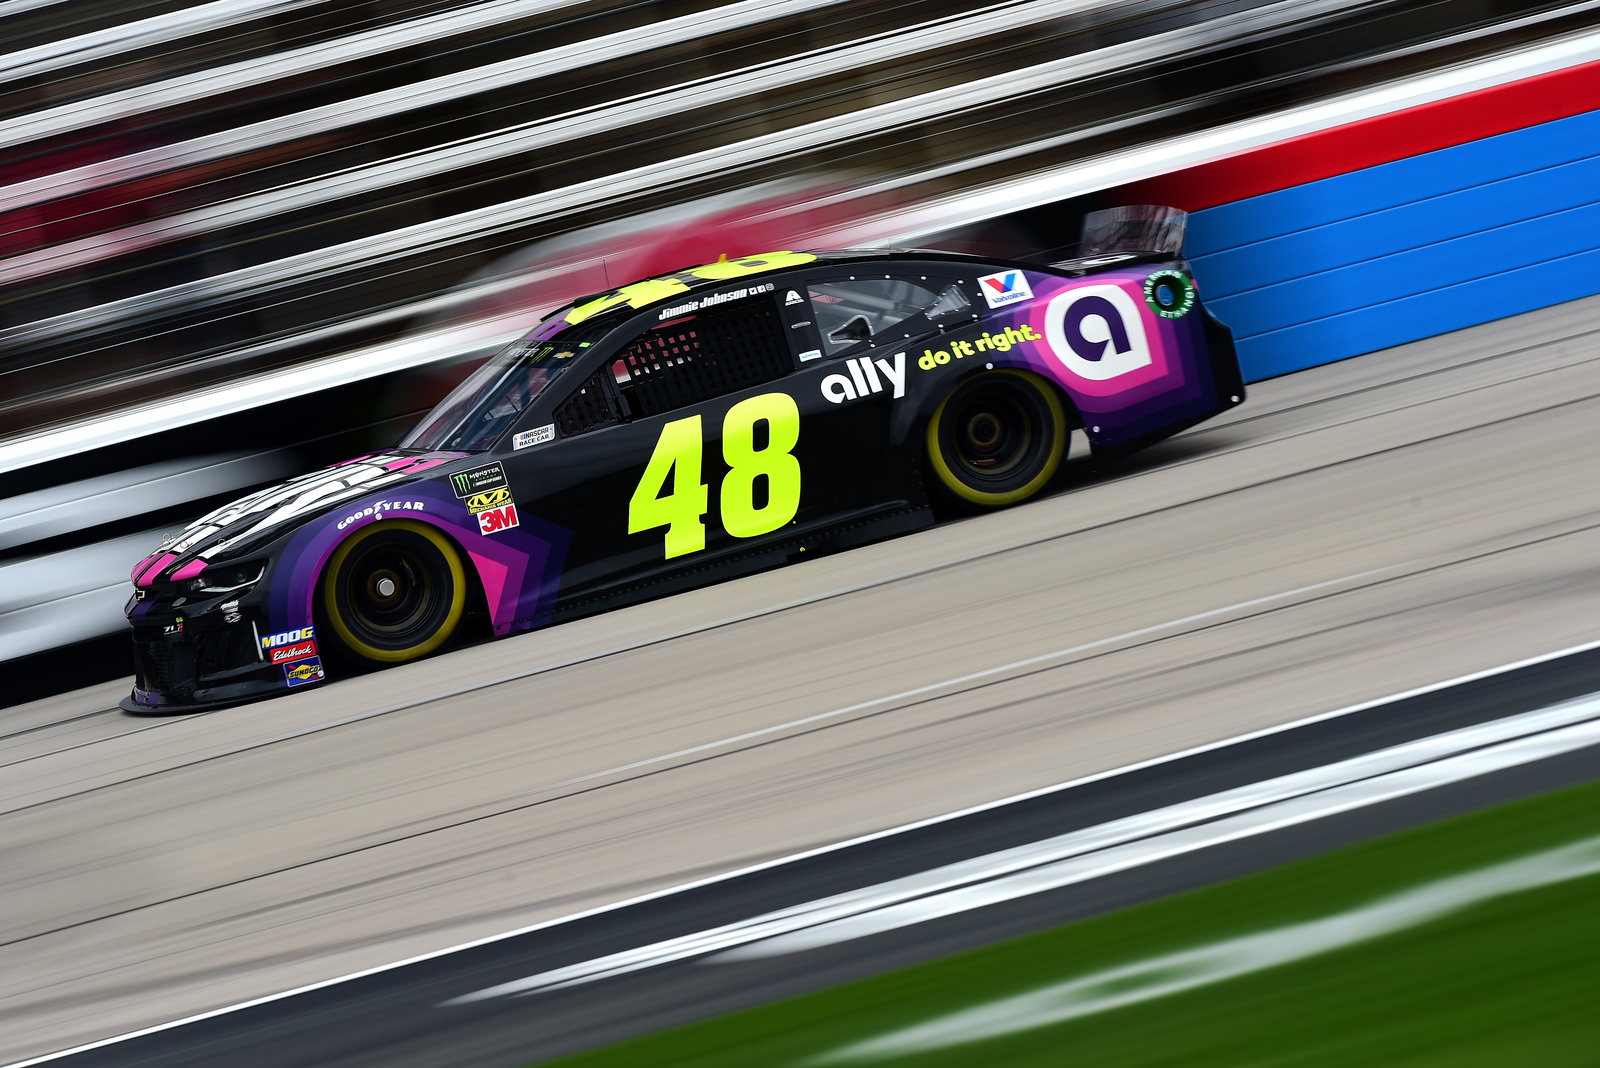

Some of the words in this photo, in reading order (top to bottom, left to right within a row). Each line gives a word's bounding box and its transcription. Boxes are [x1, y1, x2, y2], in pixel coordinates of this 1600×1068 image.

[658, 300, 699, 321] Jimmie
[699, 288, 748, 309] Johnson
[918, 350, 951, 371] do
[950, 340, 976, 359] it
[974, 324, 1042, 352] right.
[820, 352, 906, 404] ally
[519, 436, 536, 447] RACE
[536, 433, 550, 443] CAR
[525, 426, 550, 439] NASCAR
[628, 392, 801, 560] 48
[481, 505, 518, 533] 3M
[261, 626, 314, 649] MOOG
[273, 644, 312, 661] Edelbrock
[288, 665, 321, 679] SUNOCO
